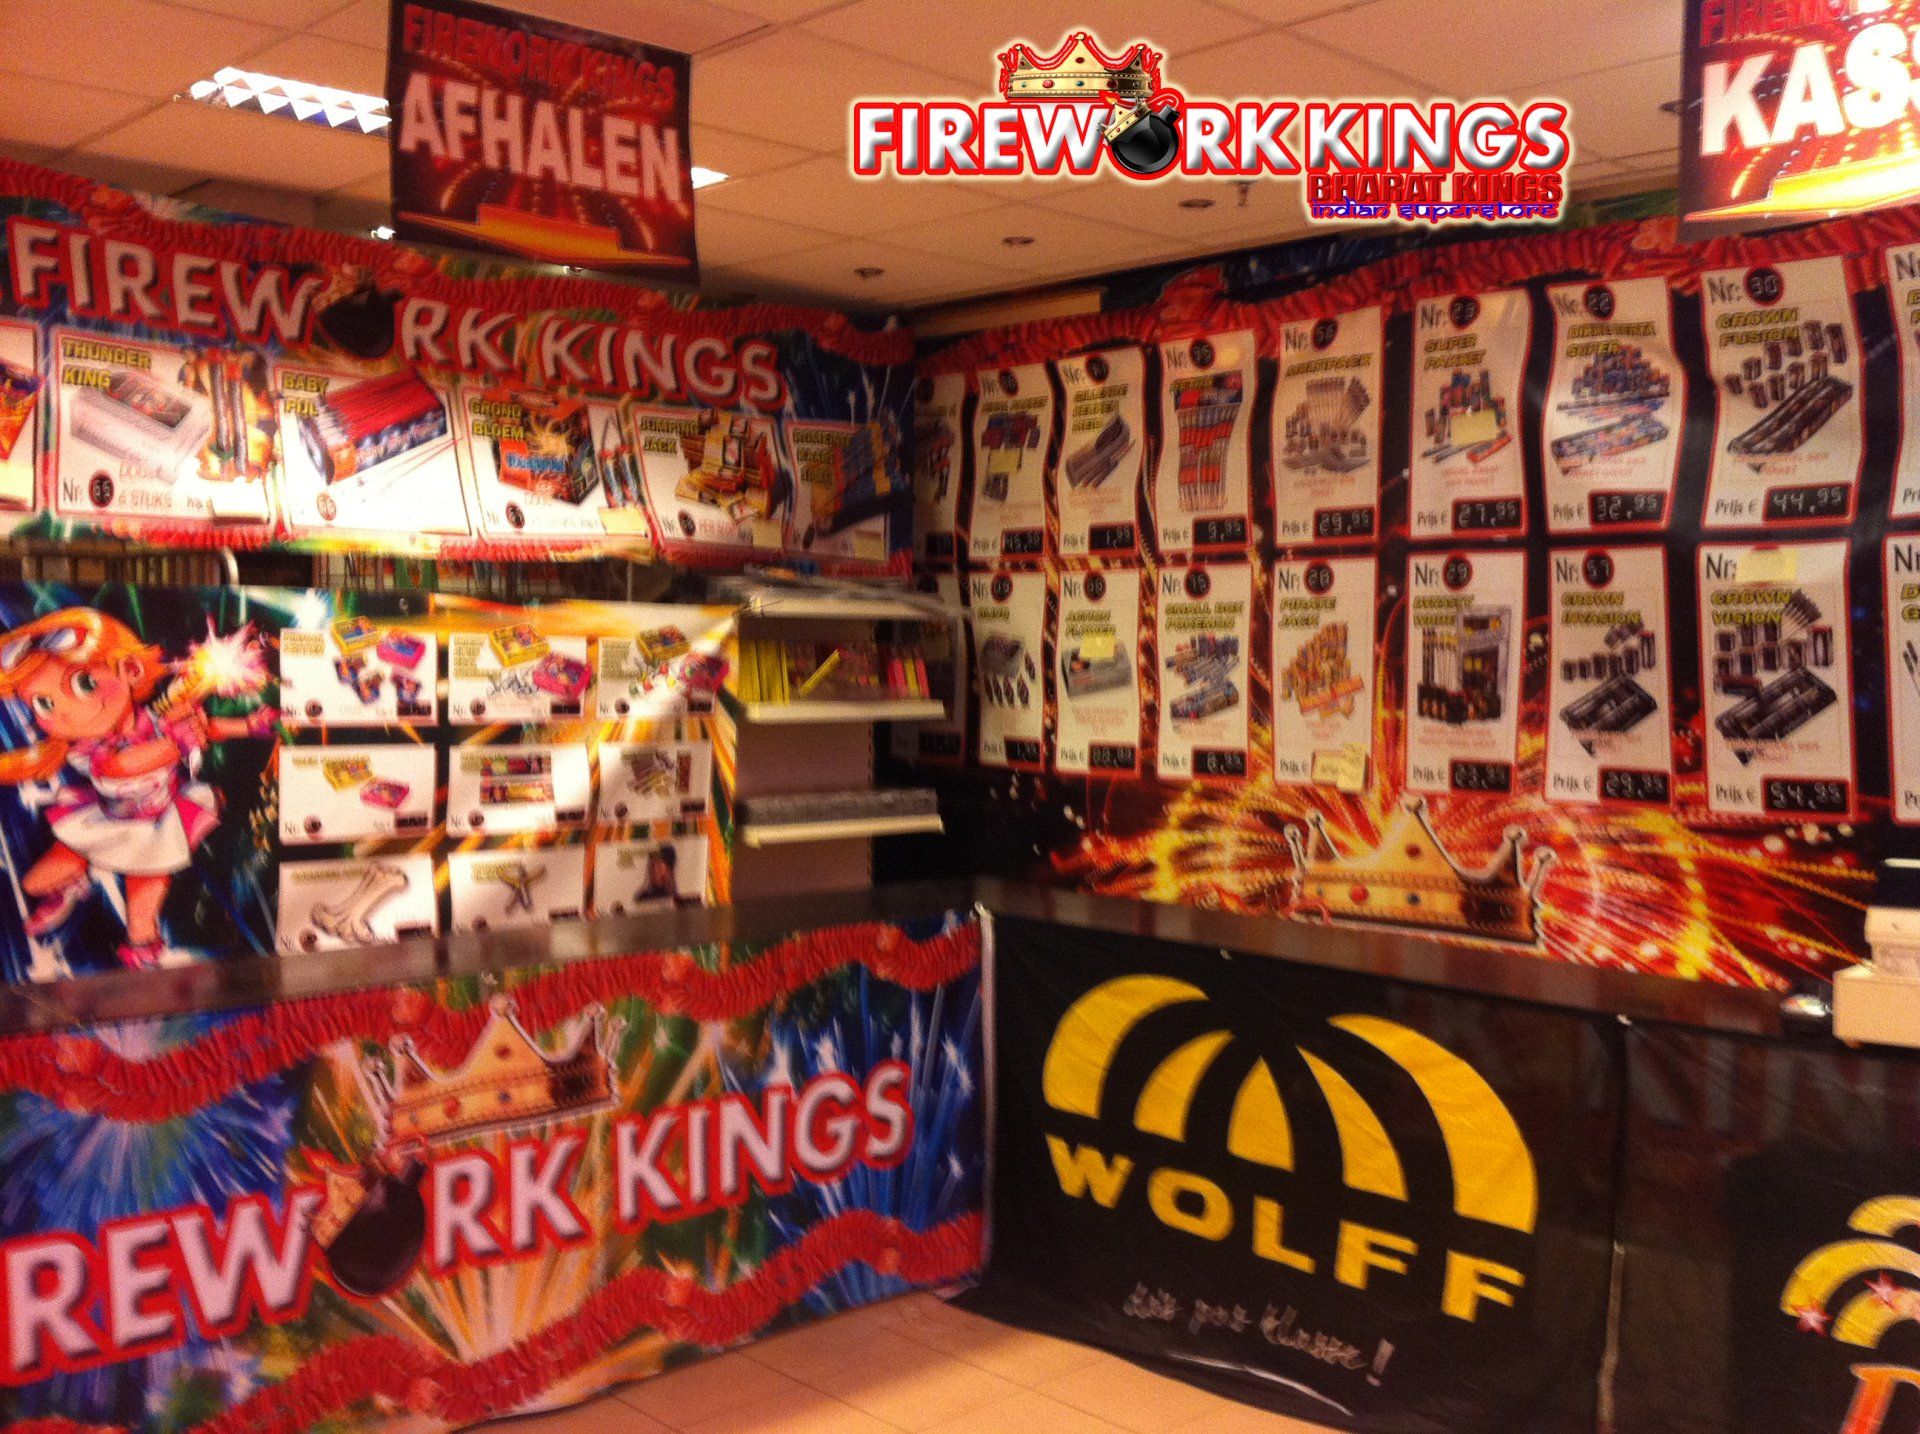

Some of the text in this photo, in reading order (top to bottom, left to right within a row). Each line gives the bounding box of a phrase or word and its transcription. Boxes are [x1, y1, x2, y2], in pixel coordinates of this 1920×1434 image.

[1702, 23, 1920, 156] KAS
[400, 72, 682, 206] AFHALEN
[1716, 307, 1798, 329] CROWN
[1718, 326, 1800, 348] FUSION
[62, 338, 152, 369] THUNDER
[540, 315, 780, 405] KINGS
[62, 365, 111, 388] KING
[282, 372, 330, 394] BABY
[472, 420, 525, 441] BLOEM
[618, 1062, 911, 1224] KINGS
[1045, 1133, 1525, 1322] WOLFF
